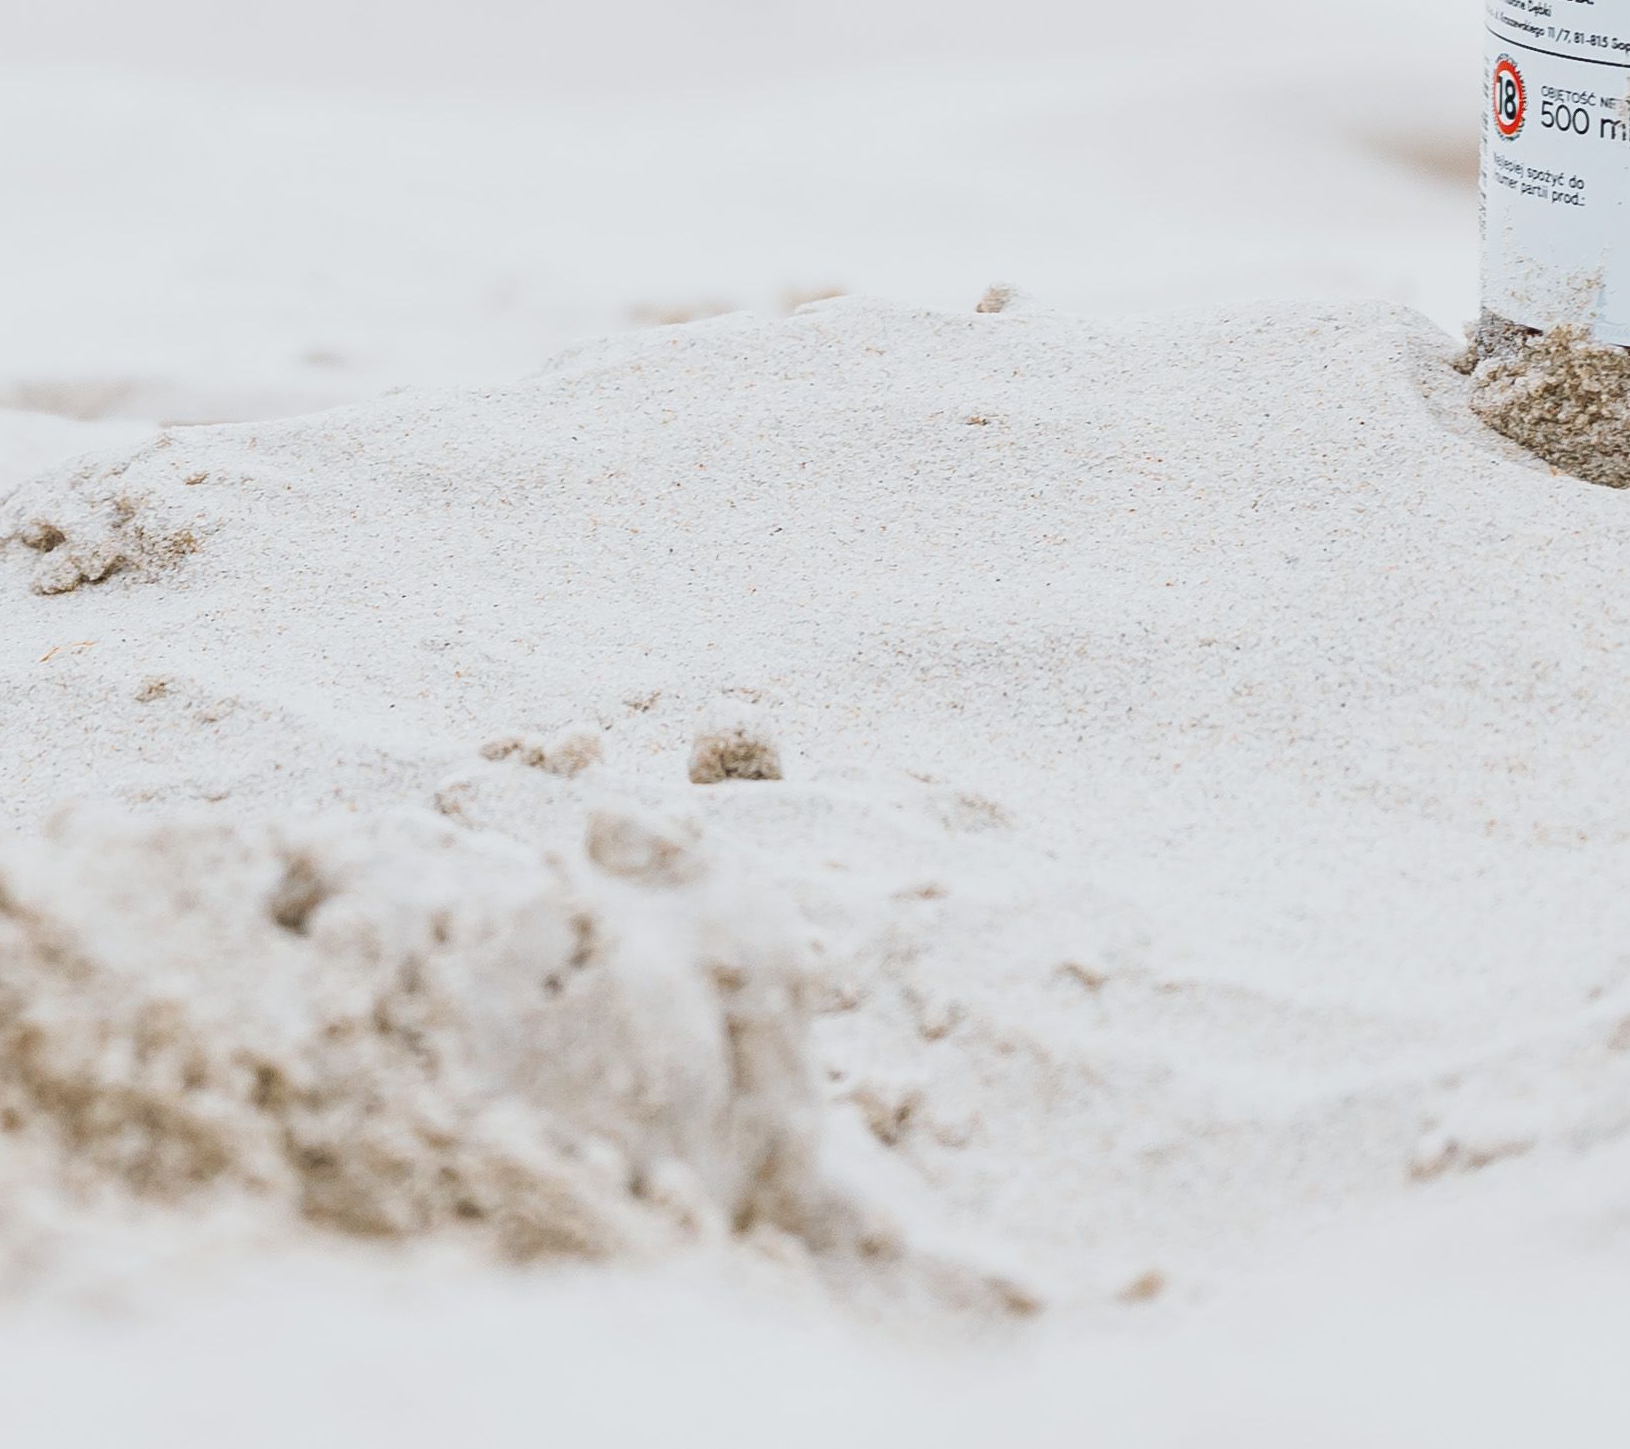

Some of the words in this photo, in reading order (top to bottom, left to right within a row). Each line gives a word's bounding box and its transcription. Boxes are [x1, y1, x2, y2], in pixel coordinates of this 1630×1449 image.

[1574, 32, 1608, 48] 81-815
[1497, 75, 1517, 120] 18
[1541, 101, 1589, 134] 500
[1527, 167, 1564, 187] spożyć
[1569, 175, 1585, 190] do
